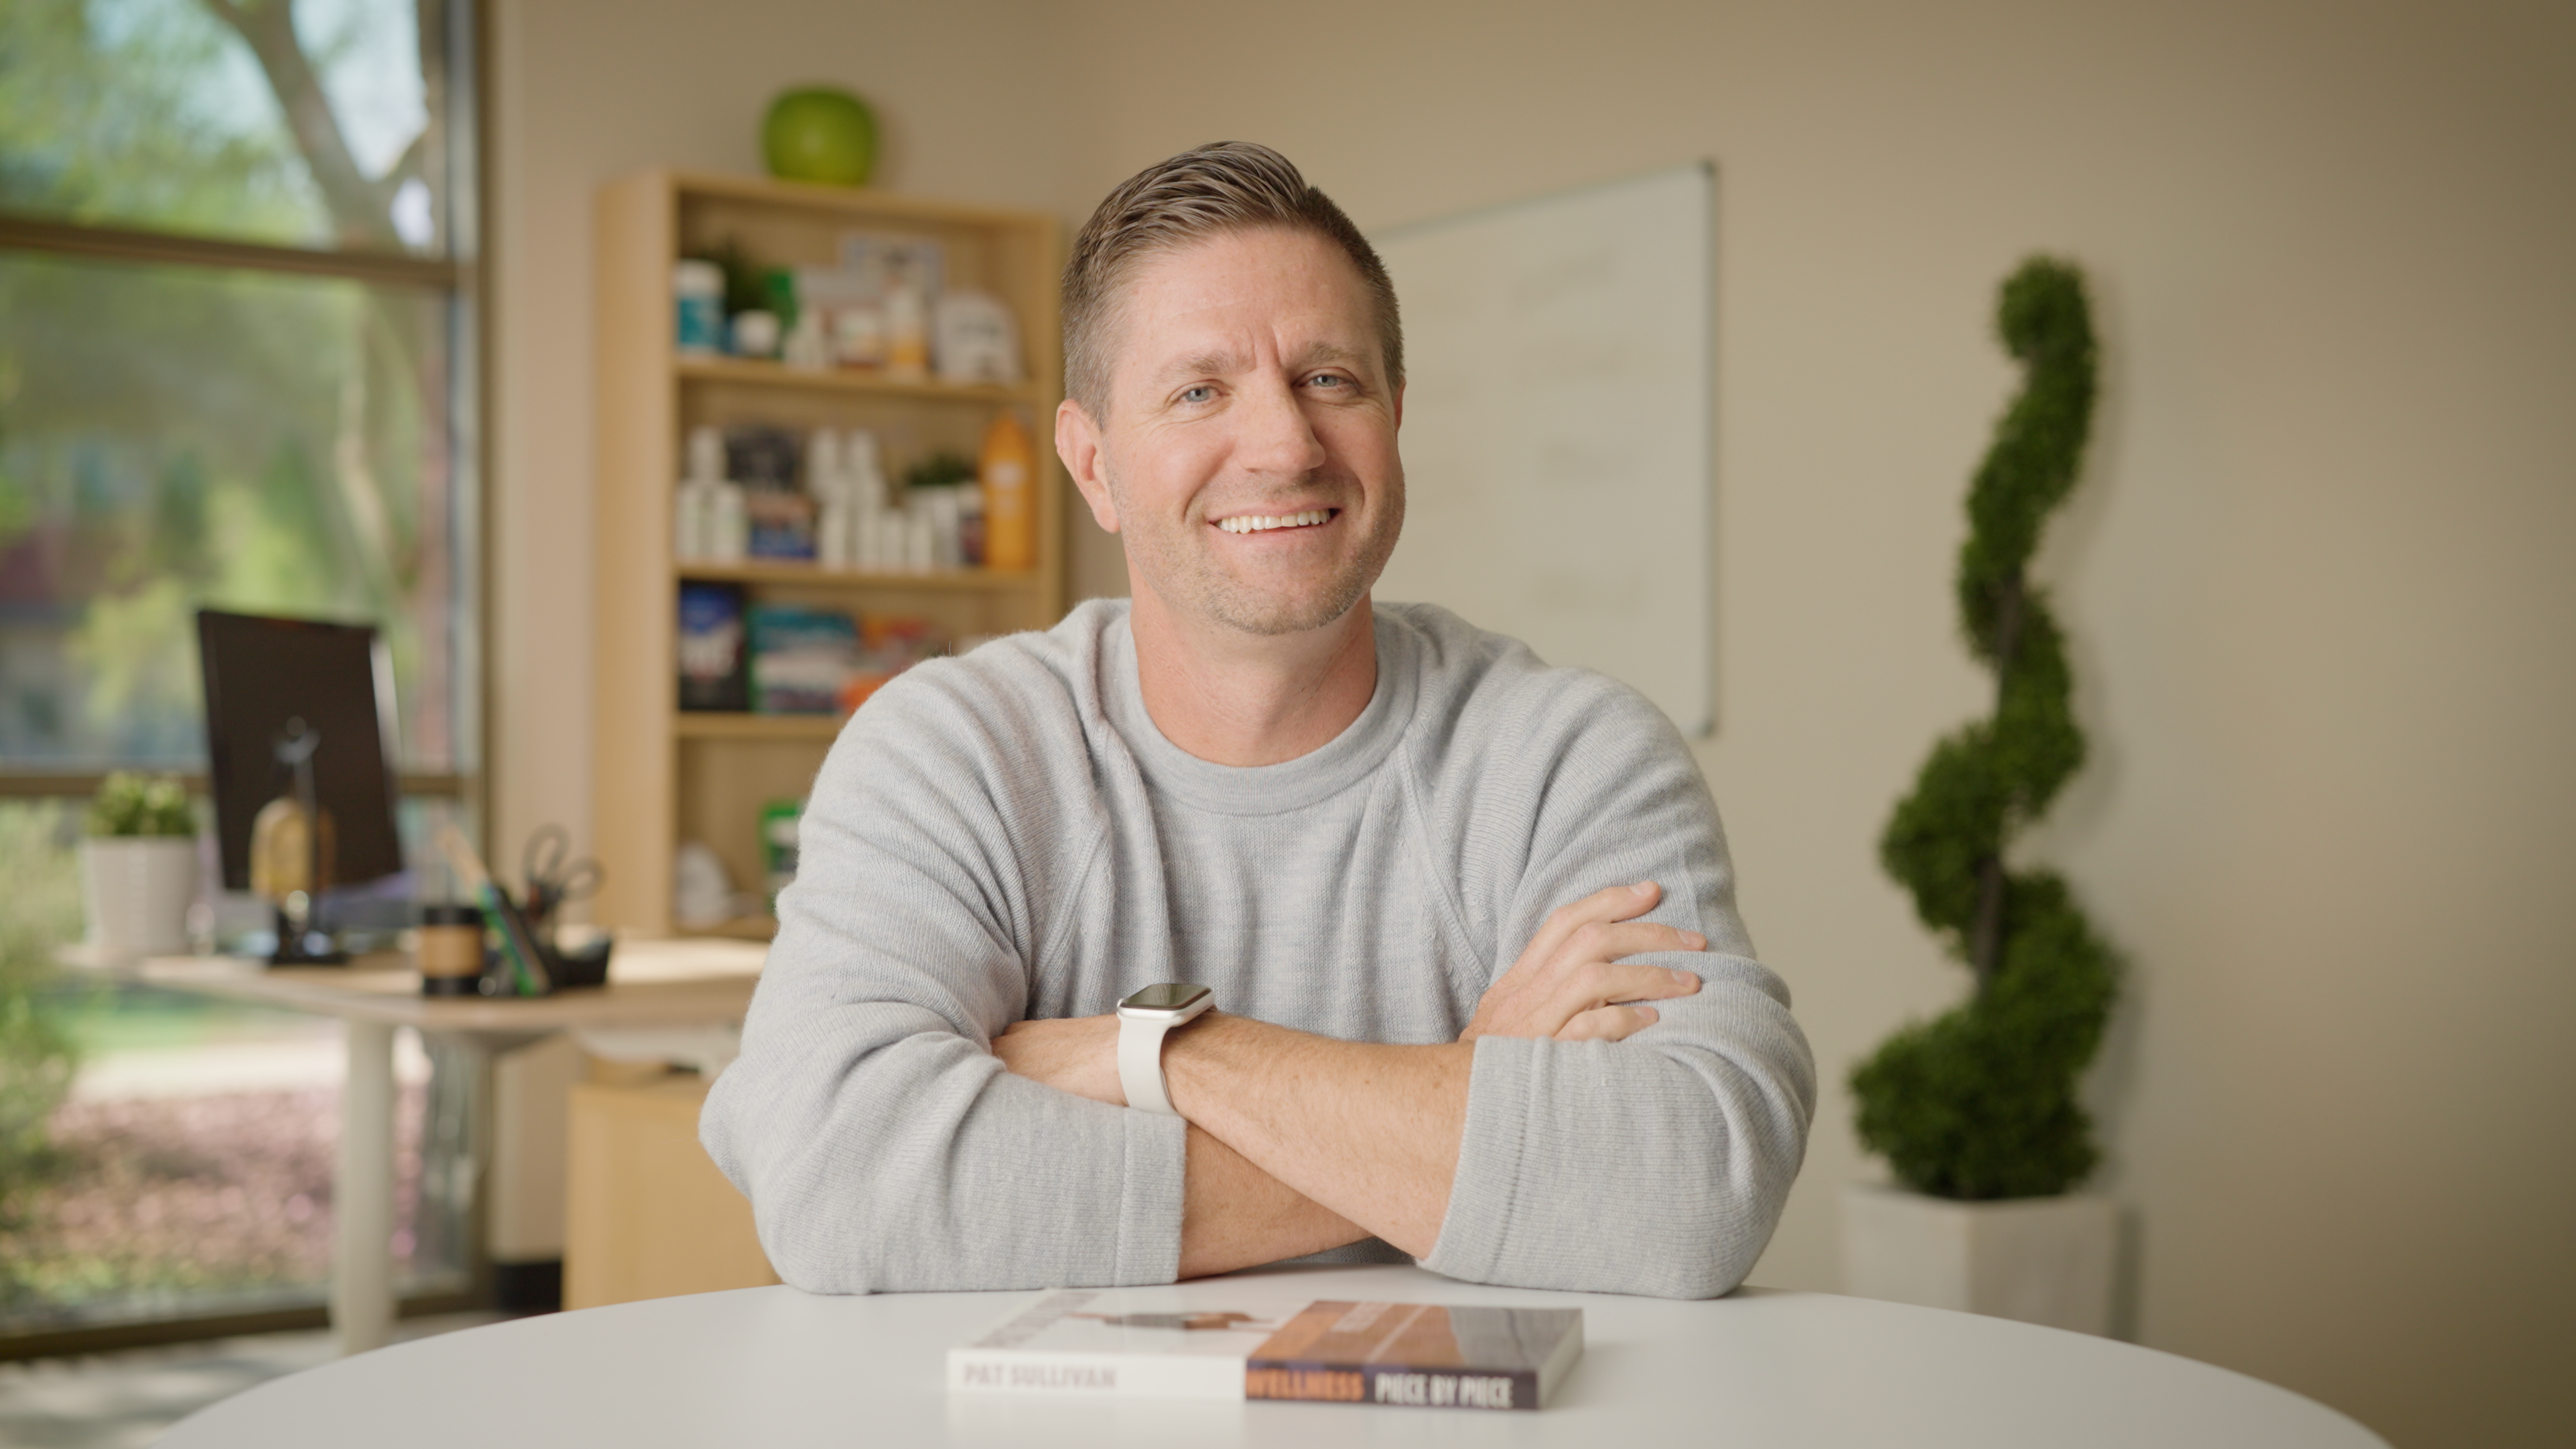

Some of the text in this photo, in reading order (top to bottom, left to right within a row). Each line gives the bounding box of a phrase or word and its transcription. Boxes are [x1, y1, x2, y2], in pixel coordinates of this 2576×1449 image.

[964, 1363, 1116, 1387] PAT SULLIVAN
[1375, 1373, 1428, 1405] PIECE
[1430, 1375, 1458, 1406] BY
[1459, 1376, 1514, 1409] PIECE
